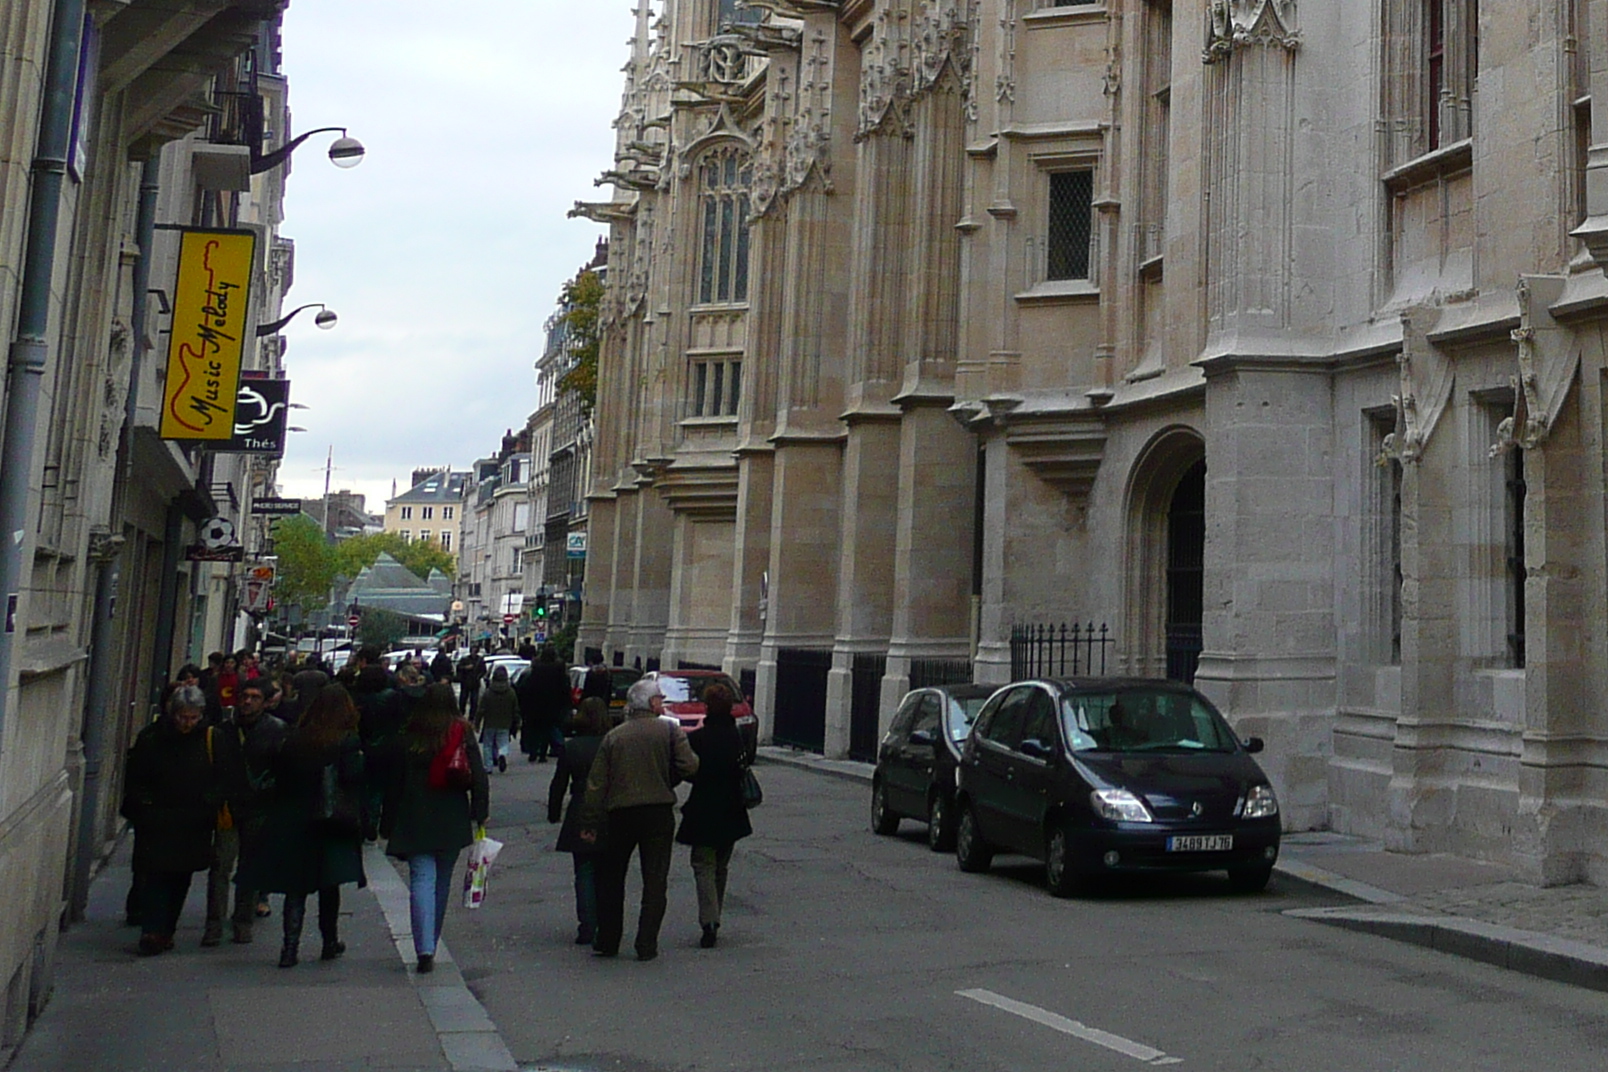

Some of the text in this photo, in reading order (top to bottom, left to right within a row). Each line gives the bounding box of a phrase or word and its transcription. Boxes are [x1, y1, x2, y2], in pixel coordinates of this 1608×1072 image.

[190, 281, 240, 425] Music Melody
[244, 438, 276, 448] Thés
